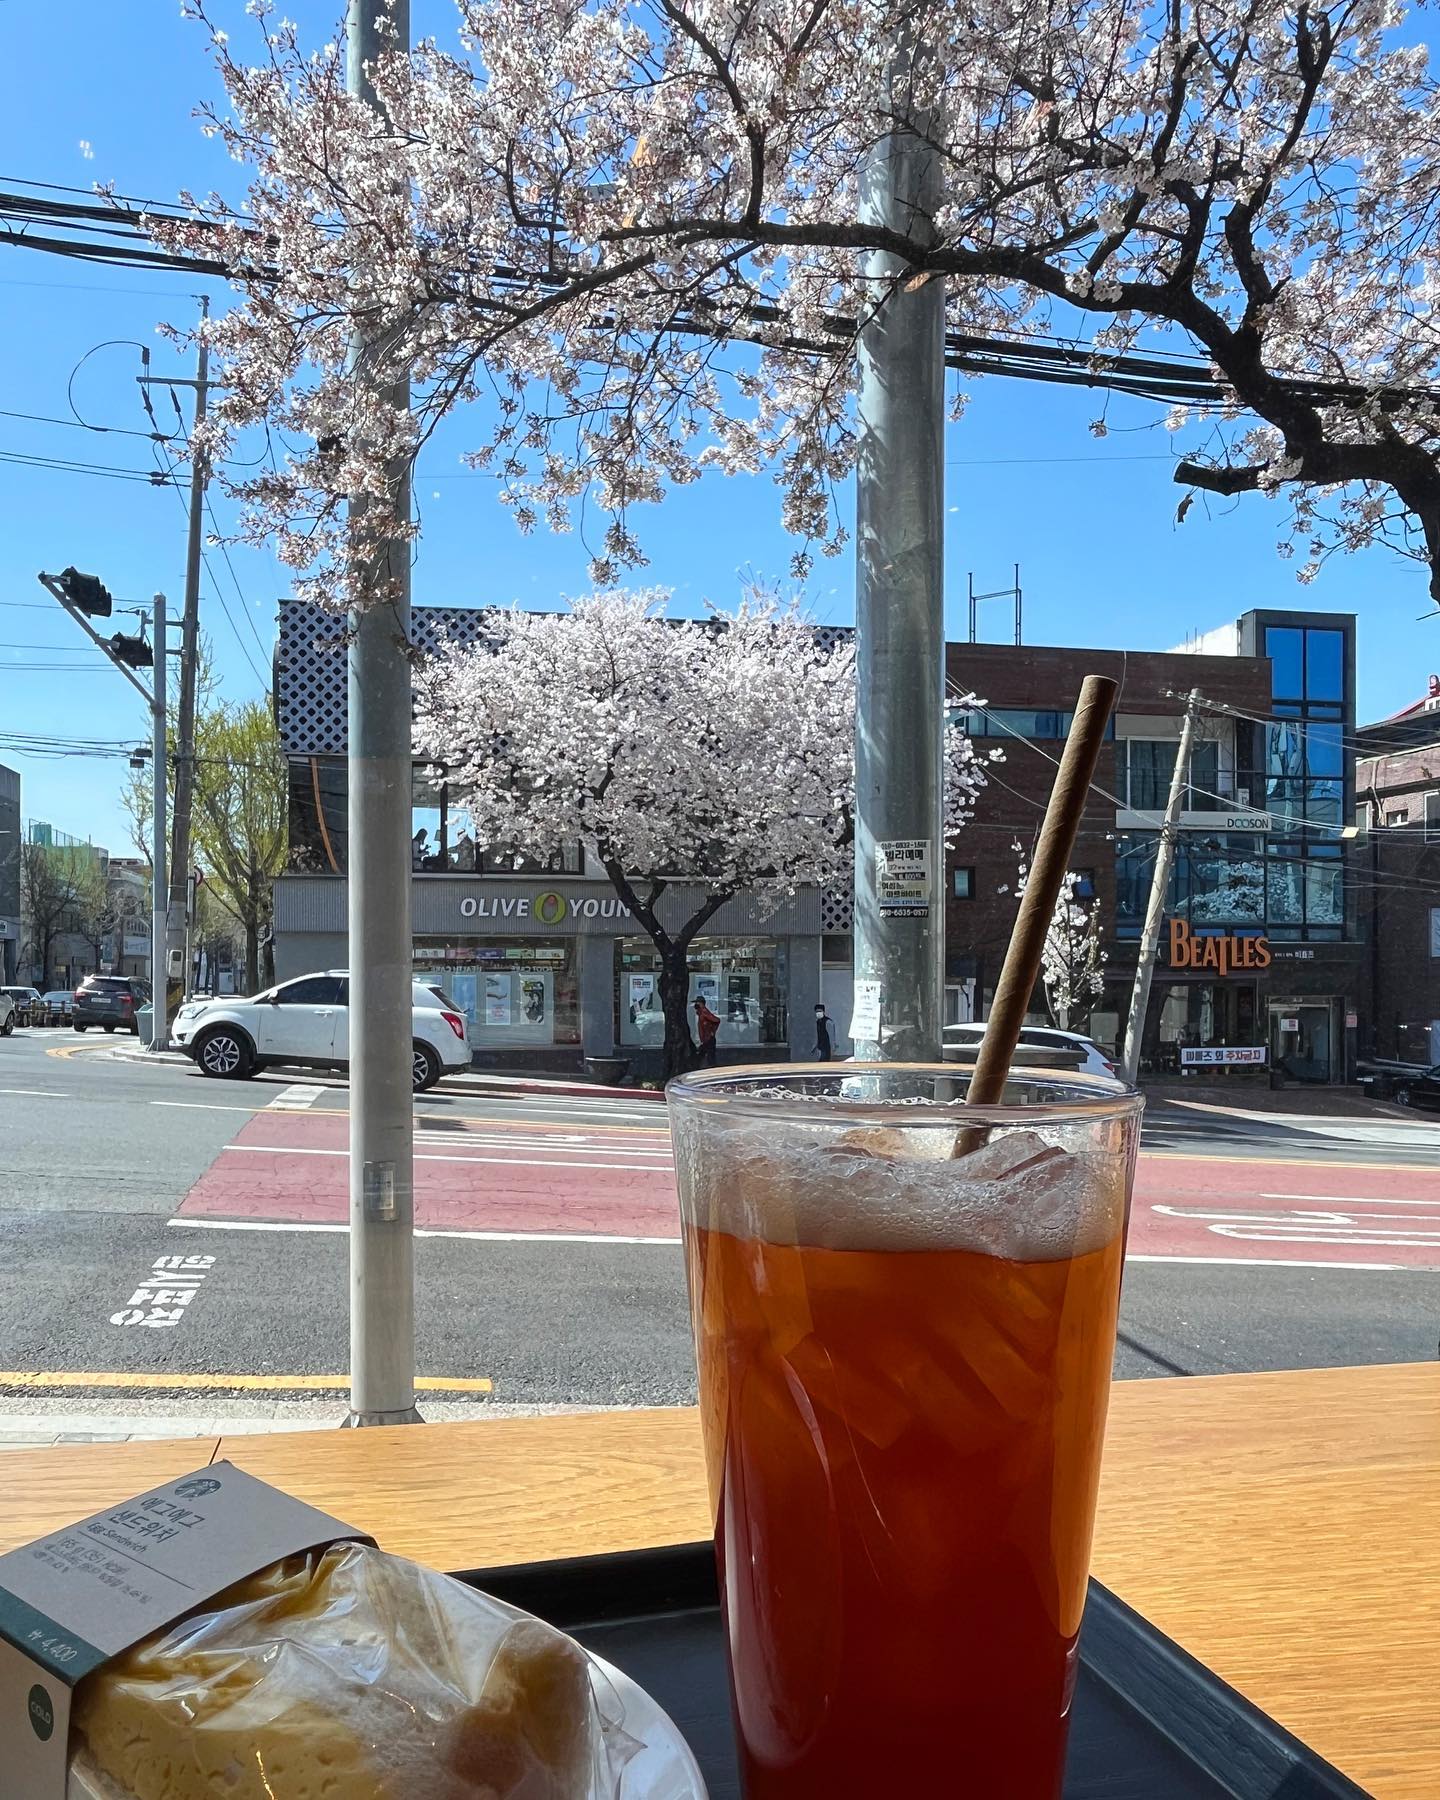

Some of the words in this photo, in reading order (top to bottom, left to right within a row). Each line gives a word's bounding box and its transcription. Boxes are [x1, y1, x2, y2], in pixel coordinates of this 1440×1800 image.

[1227, 818, 1269, 829] DOOSON
[460, 898, 529, 917] OLIVE
[568, 898, 633, 918] YOUN
[1169, 918, 1272, 976] BEATLES
[1226, 1049, 1261, 1061] 주차금지
[140, 1496, 206, 1529] 에그에그
[86, 1522, 107, 1535] Egg
[103, 1528, 149, 1553] Sandwich
[107, 1509, 180, 1544] 샌드위치
[41, 1638, 78, 1662] 4,400
[30, 1700, 52, 1724] COLD
